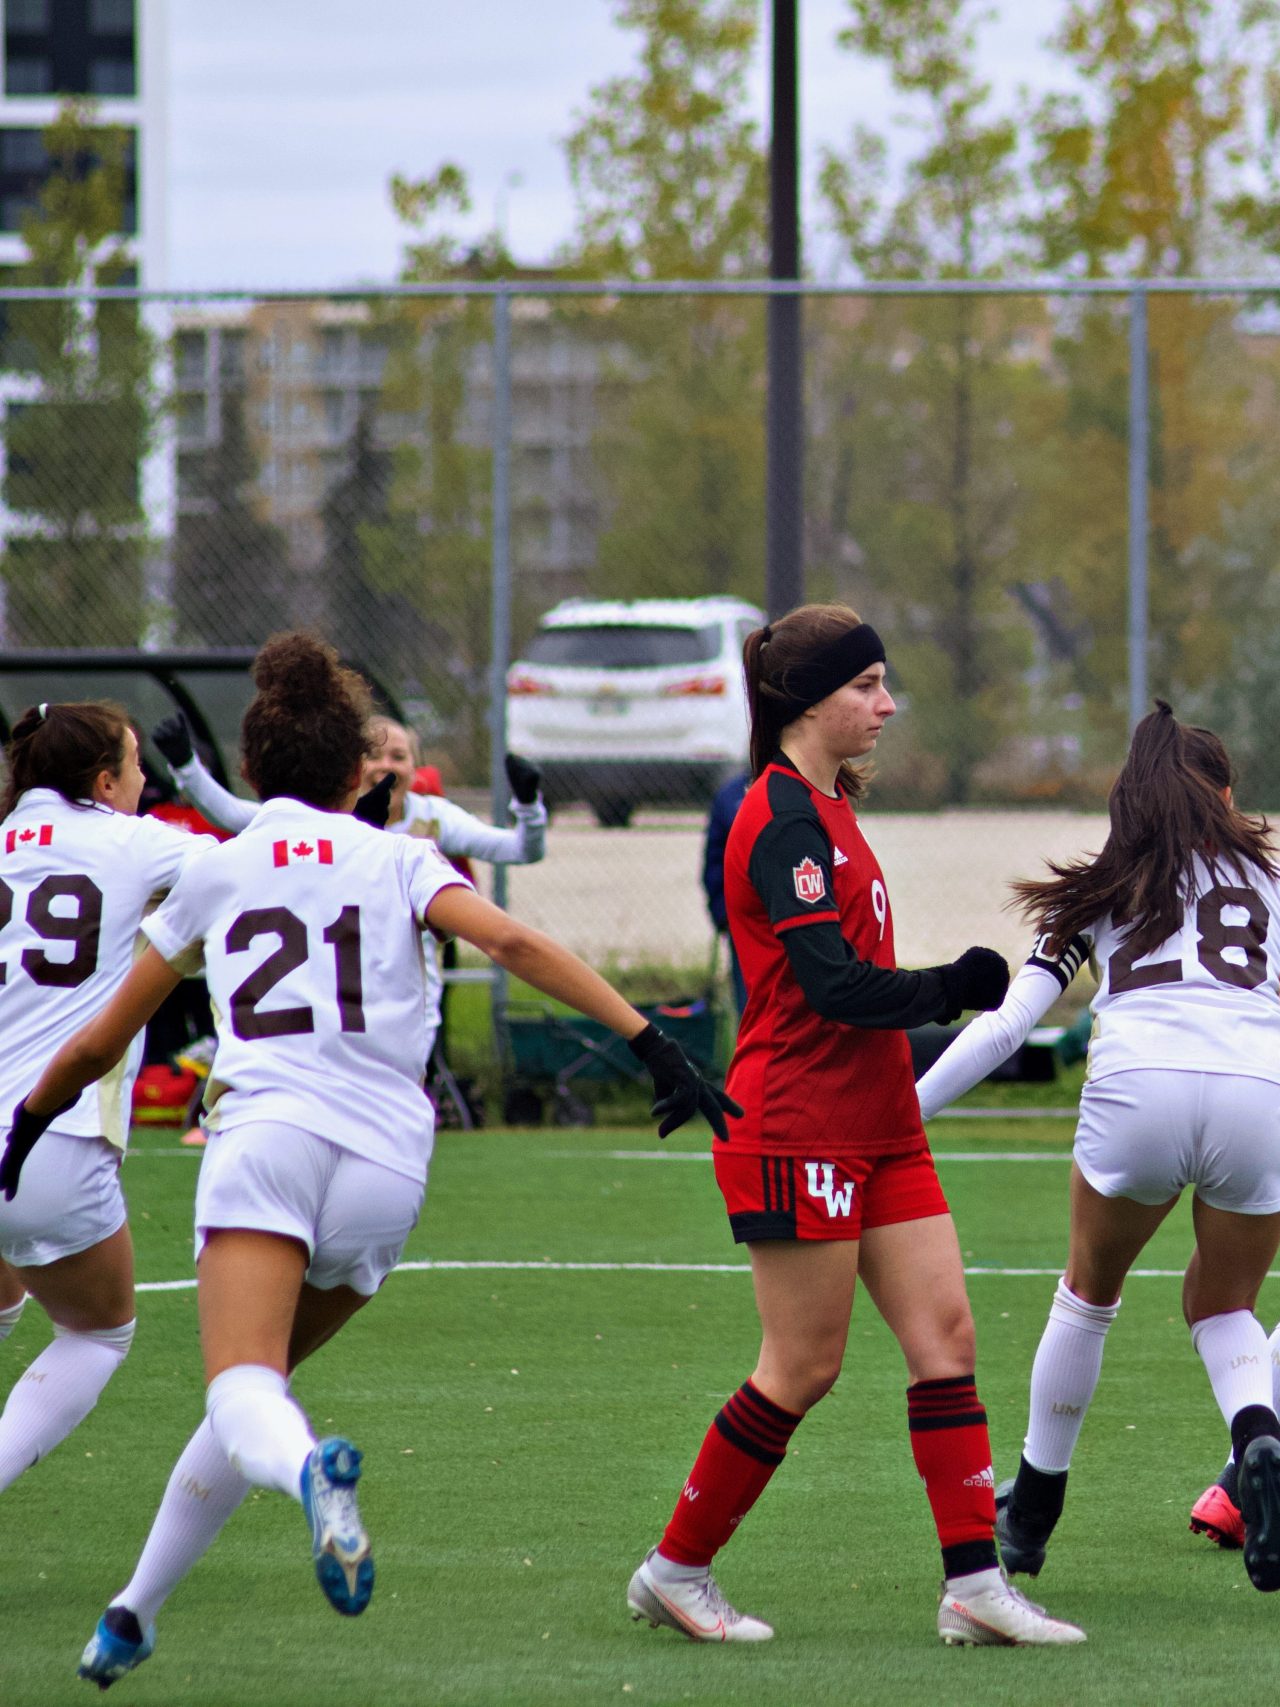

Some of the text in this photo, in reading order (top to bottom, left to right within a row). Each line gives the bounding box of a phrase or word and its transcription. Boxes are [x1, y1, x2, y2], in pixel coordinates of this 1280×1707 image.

[797, 873, 821, 895] CW
[0, 873, 103, 988] 9
[871, 879, 886, 942] 9
[1108, 886, 1270, 996] 28
[224, 905, 367, 1042] 21
[804, 1162, 856, 1218] UW
[1230, 1354, 1259, 1370] UM
[1052, 1402, 1082, 1418] UM
[683, 1478, 700, 1502] W
[963, 1478, 995, 1489] adid
